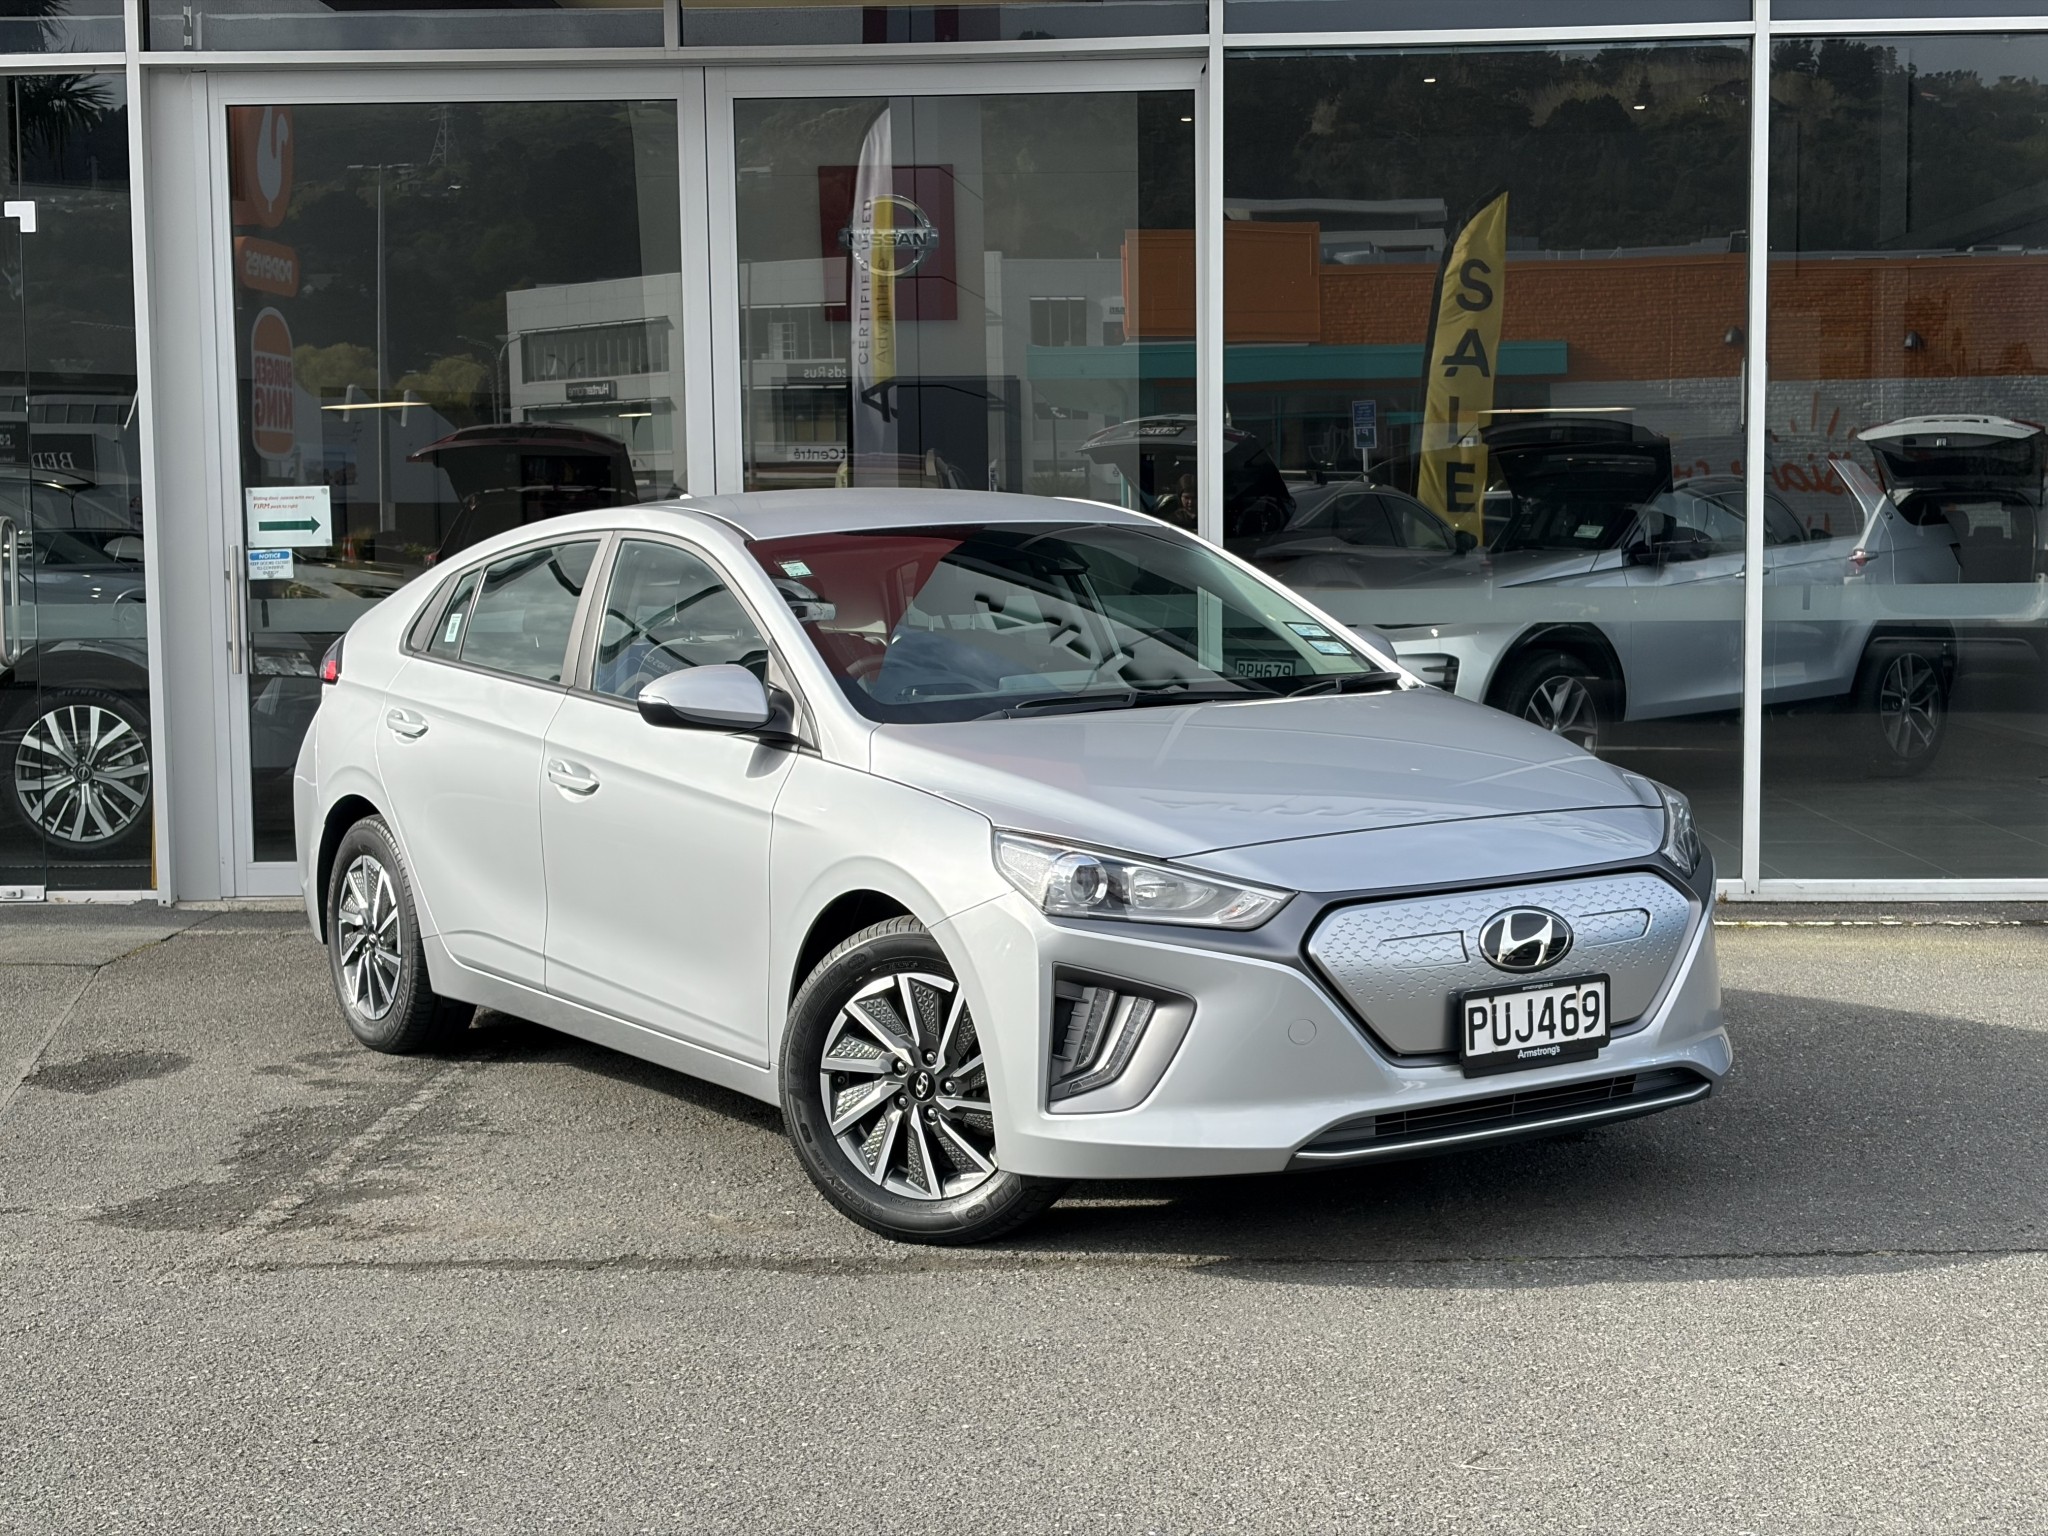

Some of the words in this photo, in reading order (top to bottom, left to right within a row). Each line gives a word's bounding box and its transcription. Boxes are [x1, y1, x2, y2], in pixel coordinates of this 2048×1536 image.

[862, 199, 873, 251] USED
[858, 259, 871, 365] CERTIFIED
[1442, 258, 1494, 513] SALE
[1239, 663, 1292, 678] RPH679
[1468, 989, 1600, 1051] PUJ469
[1517, 1044, 1561, 1059] Armstrong's
